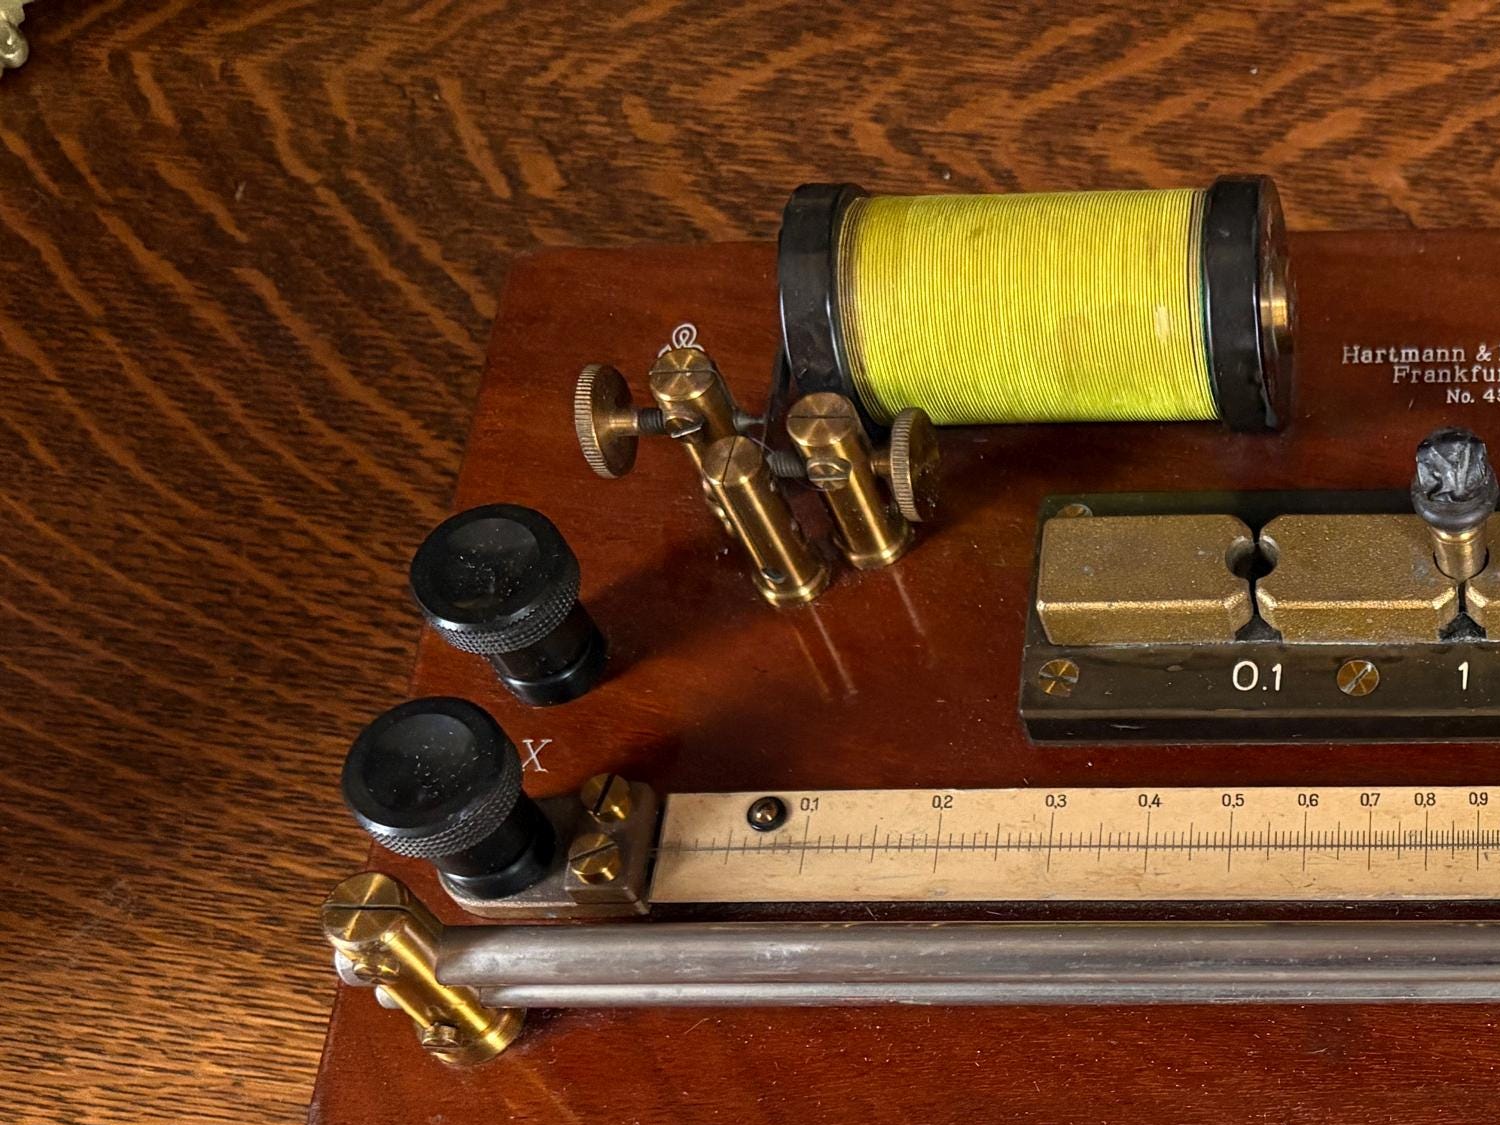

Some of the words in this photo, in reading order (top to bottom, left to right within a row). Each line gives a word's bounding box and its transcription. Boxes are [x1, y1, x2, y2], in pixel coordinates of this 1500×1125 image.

[1342, 345, 1466, 364] Hartmann
[1476, 344, 1492, 362] &
[1446, 389, 1475, 404] No.
[1232, 660, 1282, 691] 0.1
[1458, 661, 1470, 690] 1
[522, 739, 552, 773] X
[800, 797, 819, 812] 0,1
[932, 795, 953, 810] 0,2
[1046, 794, 1068, 809] 0,3
[1138, 793, 1163, 808] 0,4
[1222, 793, 1245, 808] 0,5
[1297, 793, 1319, 808] 0,6
[1360, 792, 1381, 807] 0,7
[1414, 792, 1437, 807] 0,8
[1468, 792, 1489, 807] 0,9
